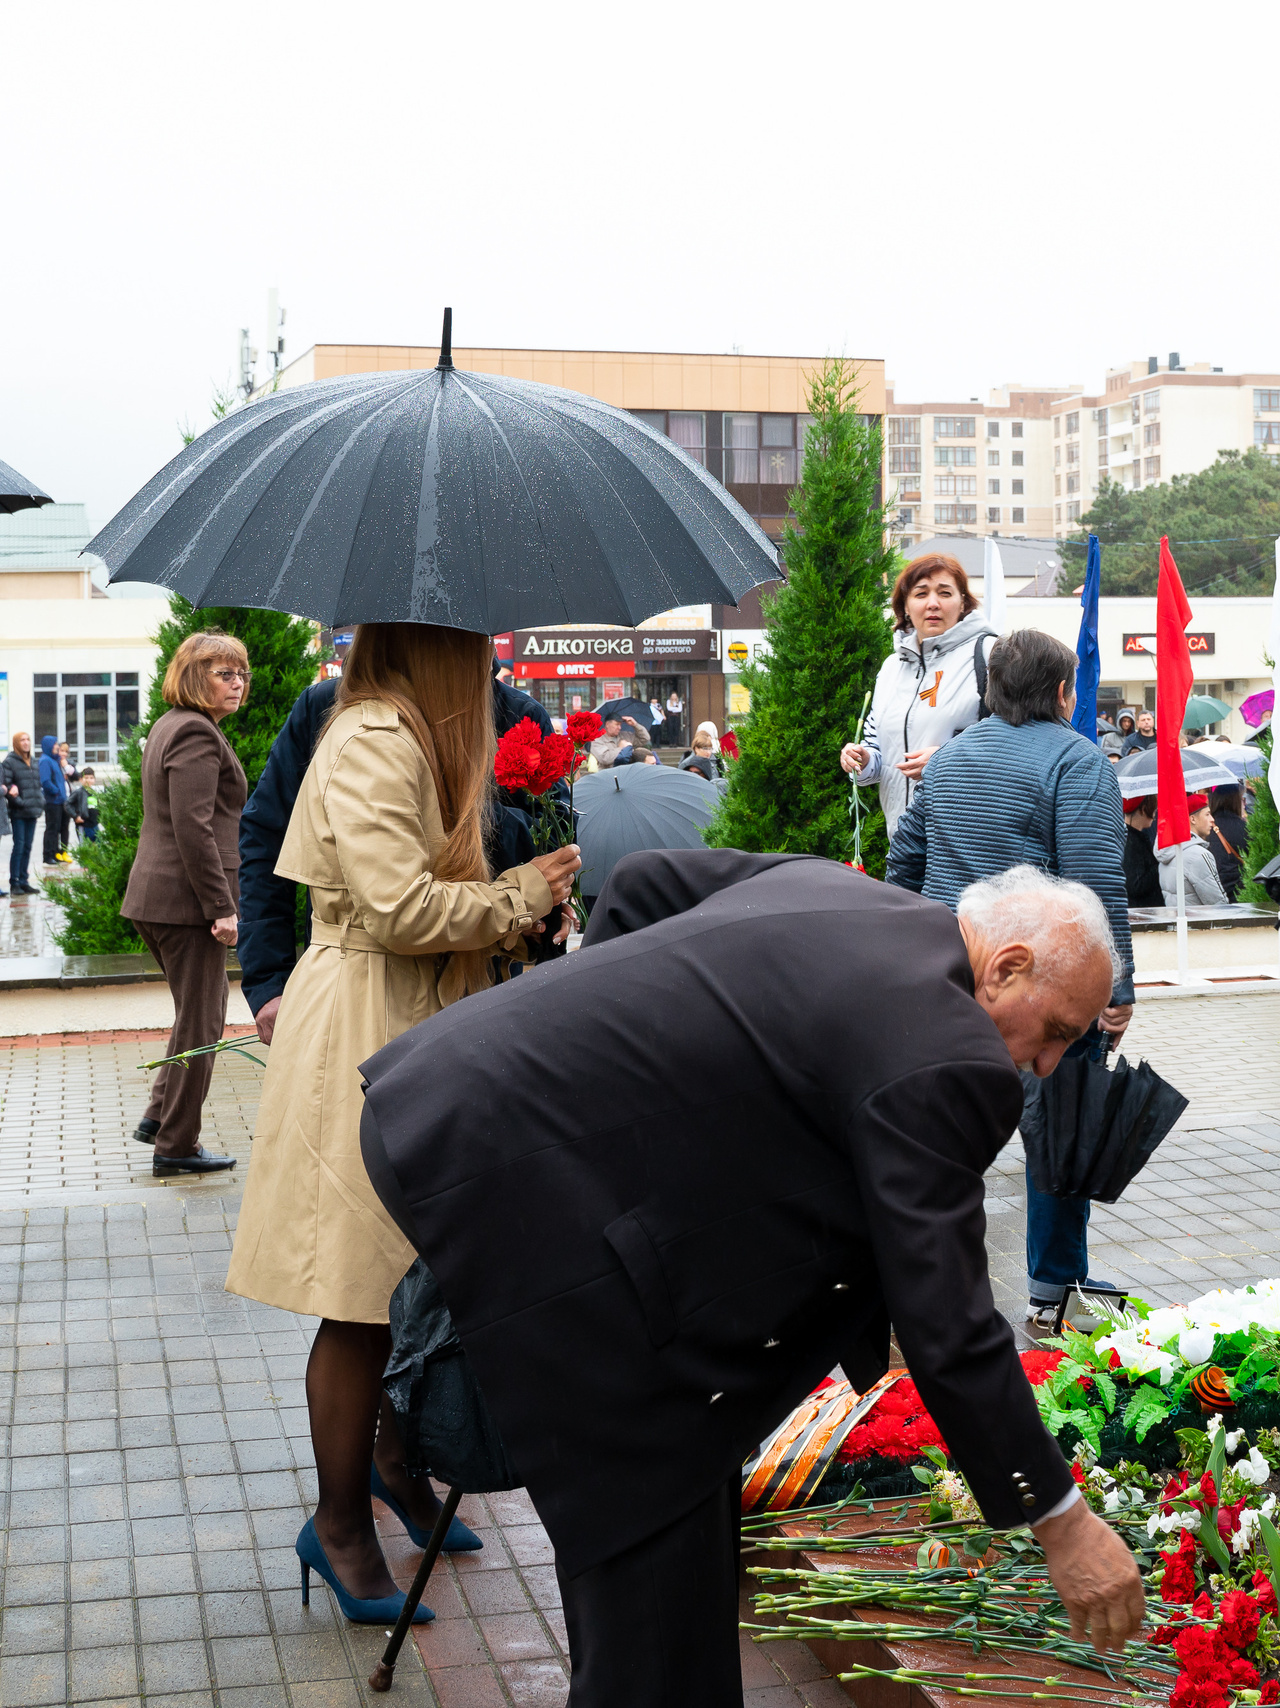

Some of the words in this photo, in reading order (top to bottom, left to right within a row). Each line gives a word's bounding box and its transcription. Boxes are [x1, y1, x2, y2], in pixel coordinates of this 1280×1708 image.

[642, 637, 656, 646] От
[655, 637, 697, 646] элитного
[642, 646, 655, 655] до
[654, 646, 692, 655] простого
[565, 664, 595, 675] МТС
